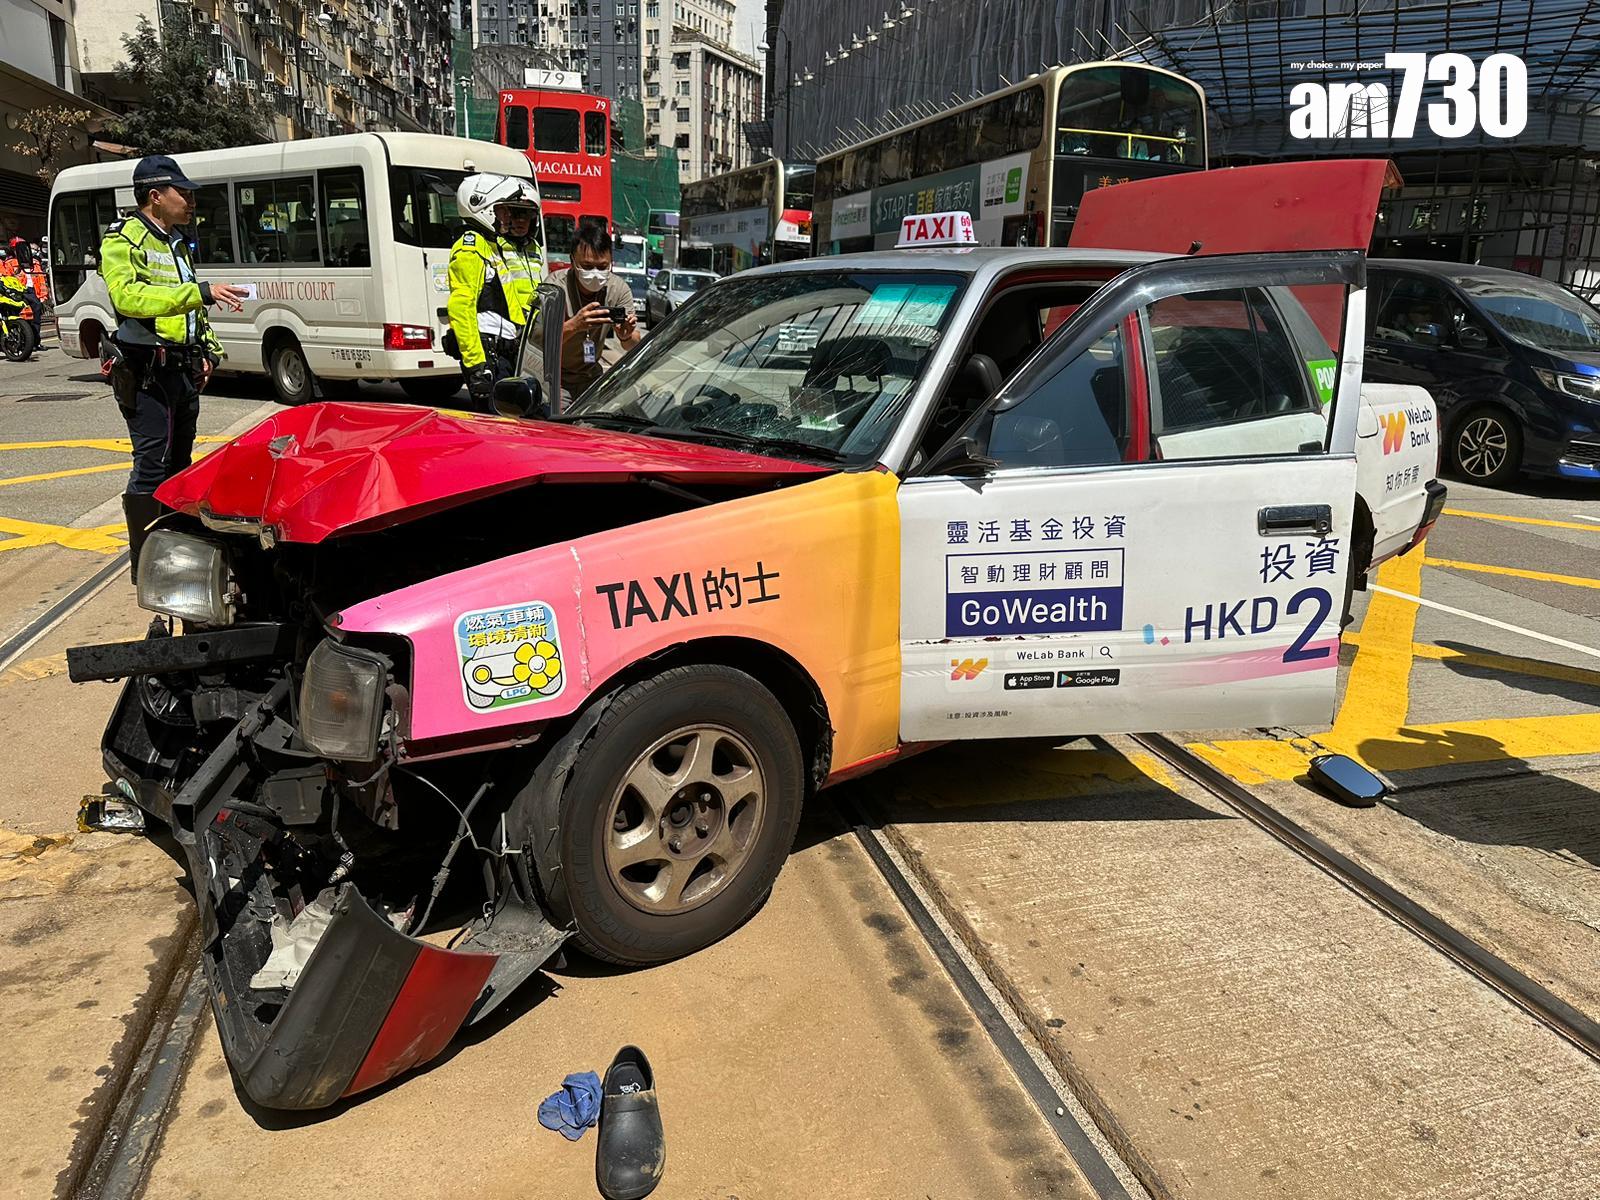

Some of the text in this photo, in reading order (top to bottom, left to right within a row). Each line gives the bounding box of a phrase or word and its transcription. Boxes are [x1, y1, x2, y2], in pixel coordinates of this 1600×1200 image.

[542, 71, 565, 85] 79
[502, 94, 513, 103] 79
[595, 100, 606, 110] 79
[532, 161, 602, 177] MACALLAN
[904, 215, 954, 241] TAXI
[961, 215, 972, 241] 的士
[297, 281, 335, 301] COURT
[1405, 405, 1432, 426] WeLab
[1410, 427, 1430, 448] Bank
[947, 515, 1126, 544] 靈活基金投資
[1260, 538, 1339, 583] 投資
[961, 560, 1109, 584] 智動理財顧問
[595, 561, 780, 629] TAXI 的士
[465, 606, 546, 632] 燃氣車輛
[961, 595, 1107, 626] GoWealth
[468, 623, 548, 648] 環境清新
[1184, 587, 1332, 663] HKD 2
[1017, 649, 1085, 660] WeLab Bank
[1075, 675, 1116, 685] Google Play
[506, 687, 528, 698] LPG
